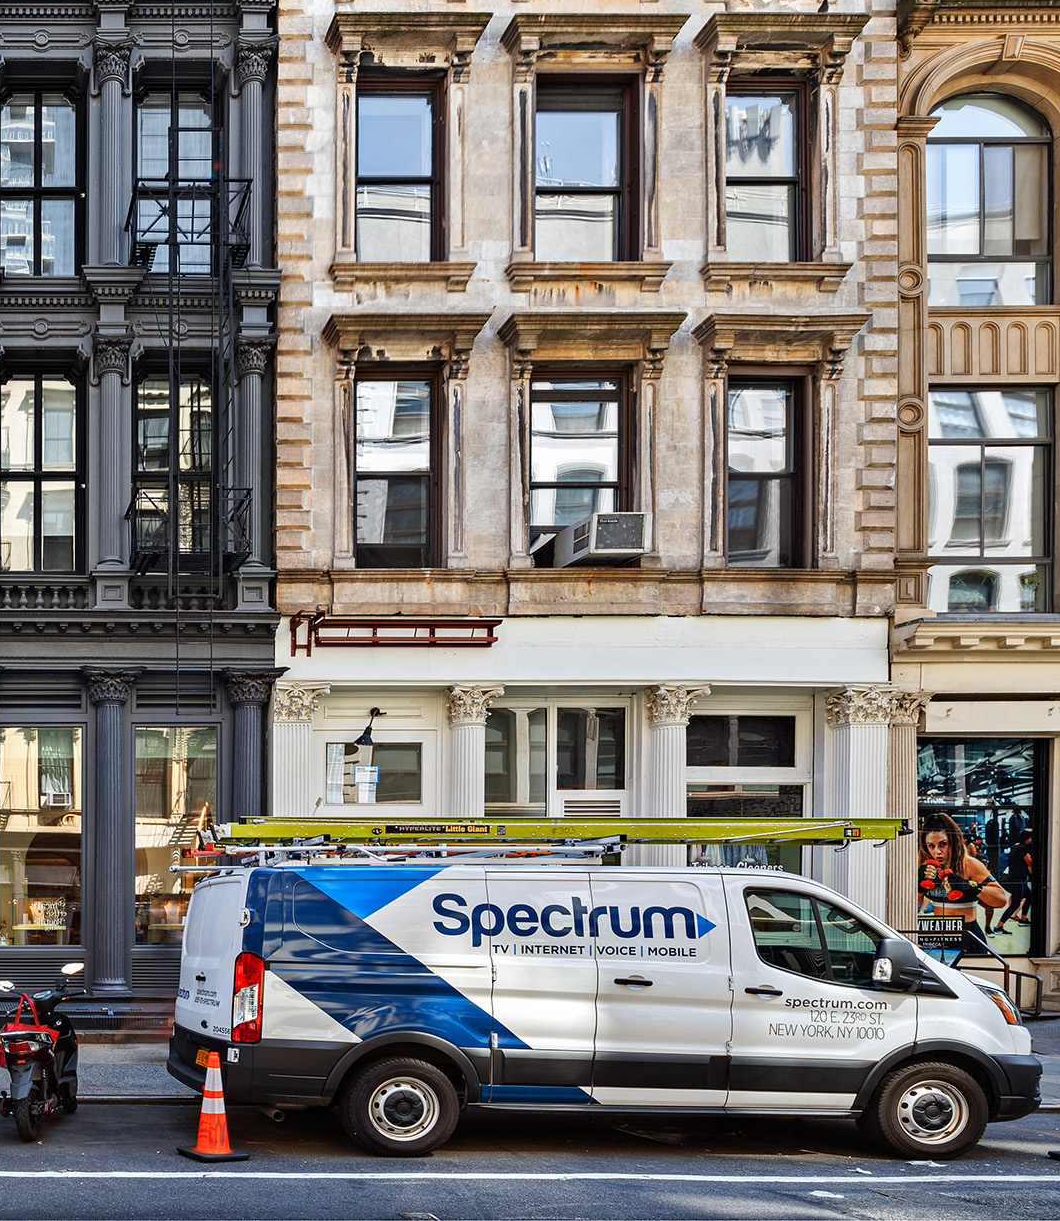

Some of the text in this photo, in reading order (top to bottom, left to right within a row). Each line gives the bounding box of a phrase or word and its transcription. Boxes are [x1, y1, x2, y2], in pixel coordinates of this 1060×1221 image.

[445, 825, 466, 833] Little
[467, 825, 488, 833] Giant
[432, 893, 697, 948] Spectrum
[492, 945, 697, 957] TV INTERNET VOICE MOBILE
[785, 998, 887, 1010] spectrum.com
[810, 1010, 884, 1025] 120 E. 23RD ST.
[769, 1024, 885, 1040] NEW YORK, NY 10010
